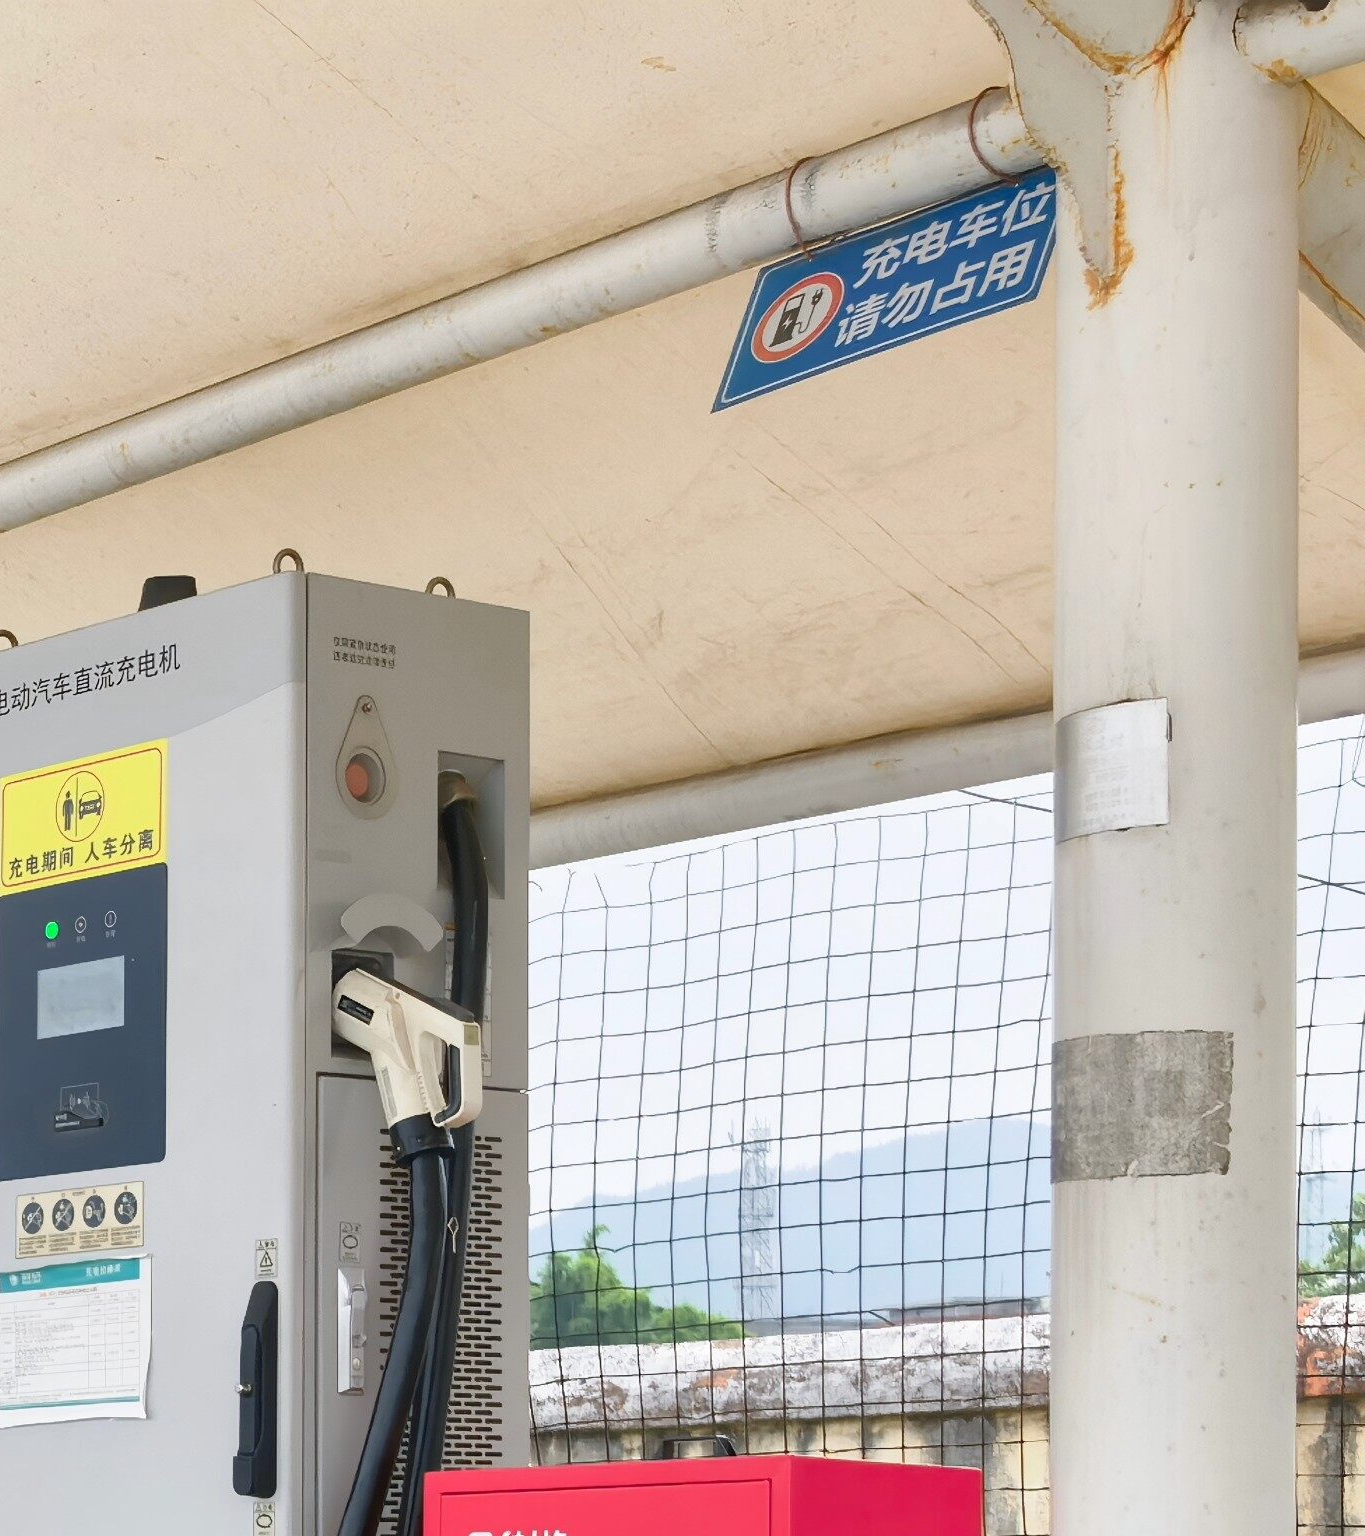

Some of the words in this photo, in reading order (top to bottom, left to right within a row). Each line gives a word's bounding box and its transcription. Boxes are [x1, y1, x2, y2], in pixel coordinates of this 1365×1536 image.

[853, 183, 1056, 288] 充电车位
[834, 240, 1035, 347] 请勿占用
[8, 851, 75, 880] 充电期间
[84, 829, 155, 864] 人车分离
